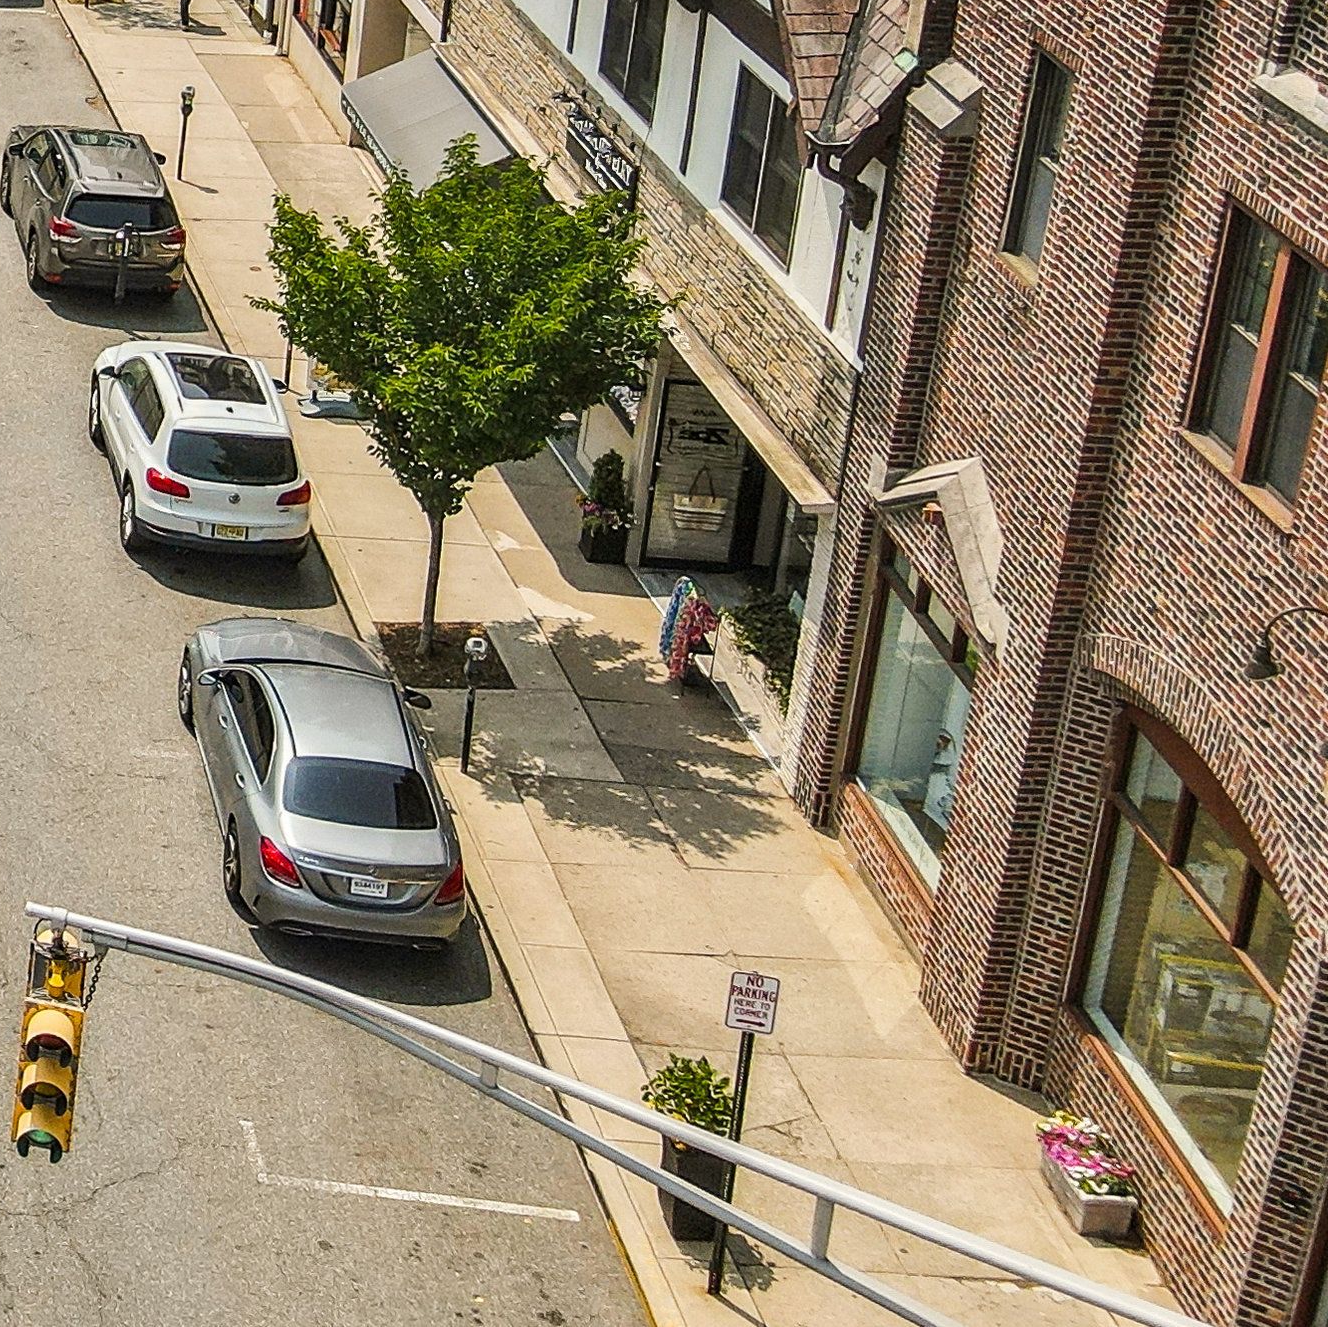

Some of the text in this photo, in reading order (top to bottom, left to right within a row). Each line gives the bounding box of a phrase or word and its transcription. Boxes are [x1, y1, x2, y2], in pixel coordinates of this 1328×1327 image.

[747, 976, 764, 988] NO
[731, 985, 776, 1002] PARKING
[734, 998, 771, 1011] HERE TO
[734, 1007, 768, 1019] CORNER
